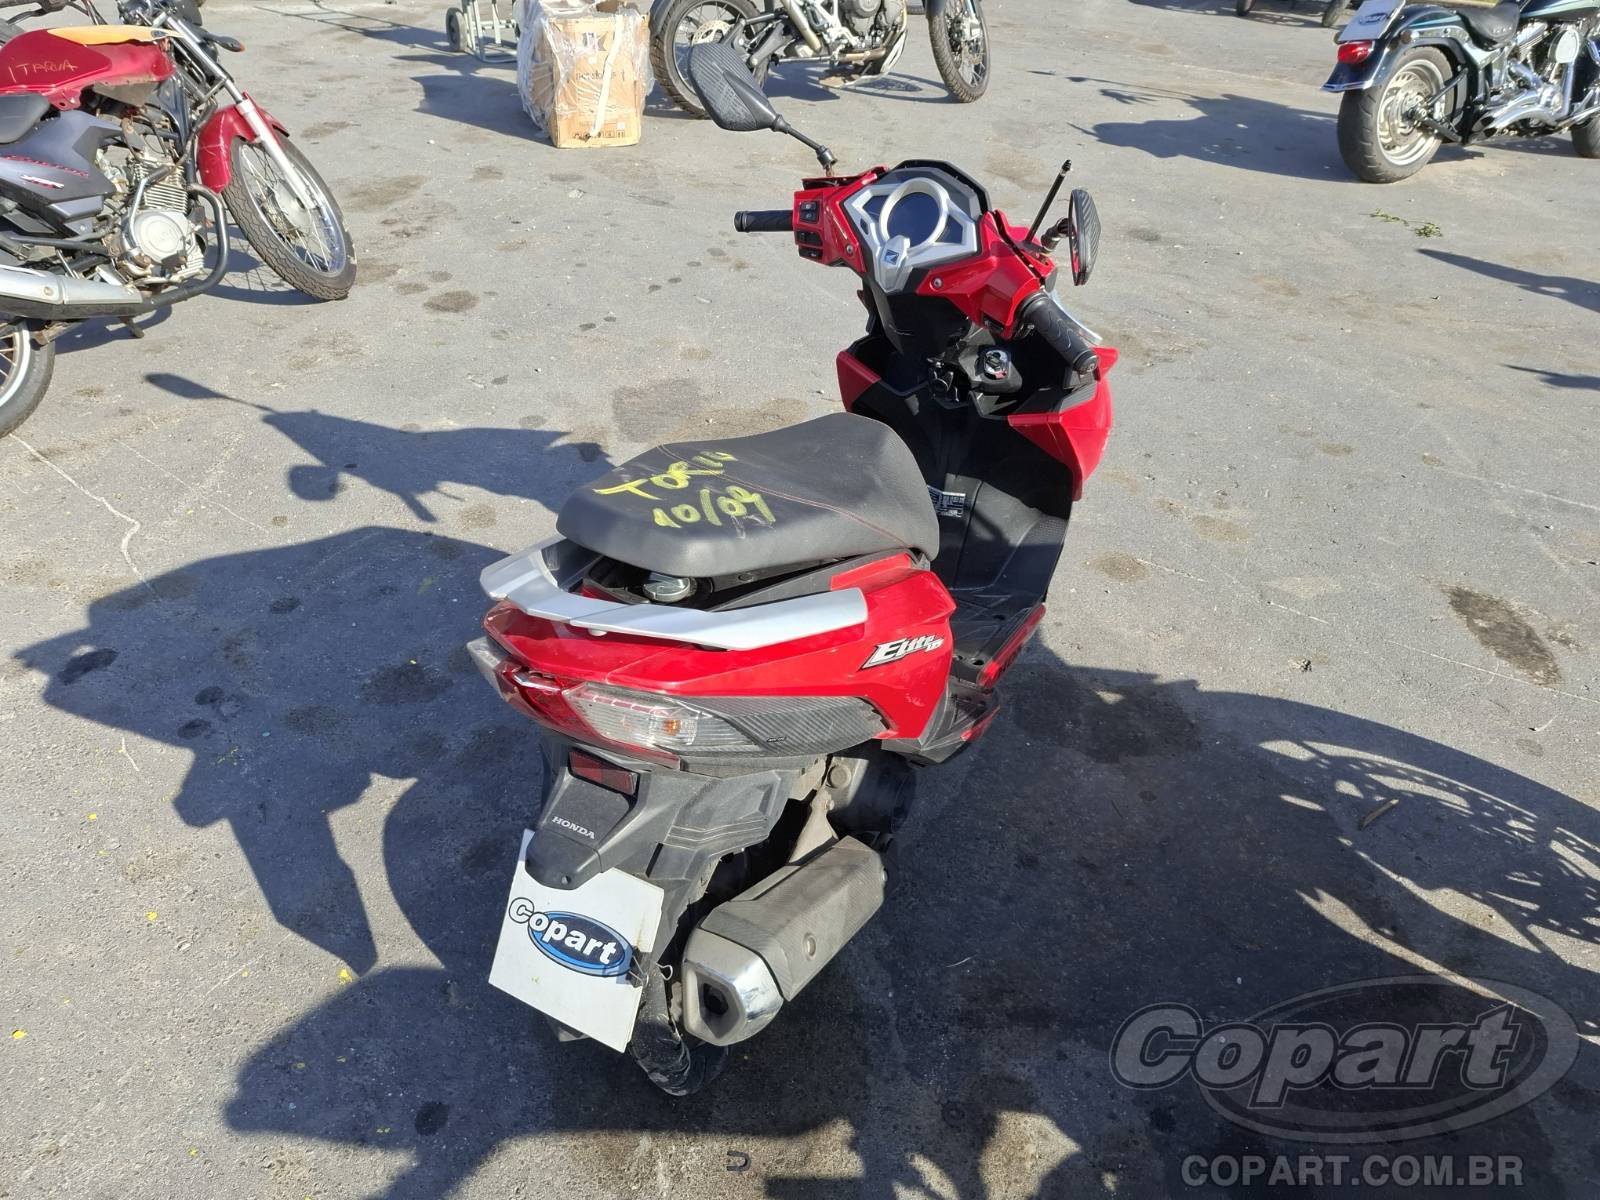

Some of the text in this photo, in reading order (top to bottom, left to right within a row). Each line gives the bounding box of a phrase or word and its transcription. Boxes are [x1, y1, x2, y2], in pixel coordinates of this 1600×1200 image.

[862, 634, 935, 669] Elite
[551, 815, 595, 839] HONDA
[508, 896, 617, 965] Copart
